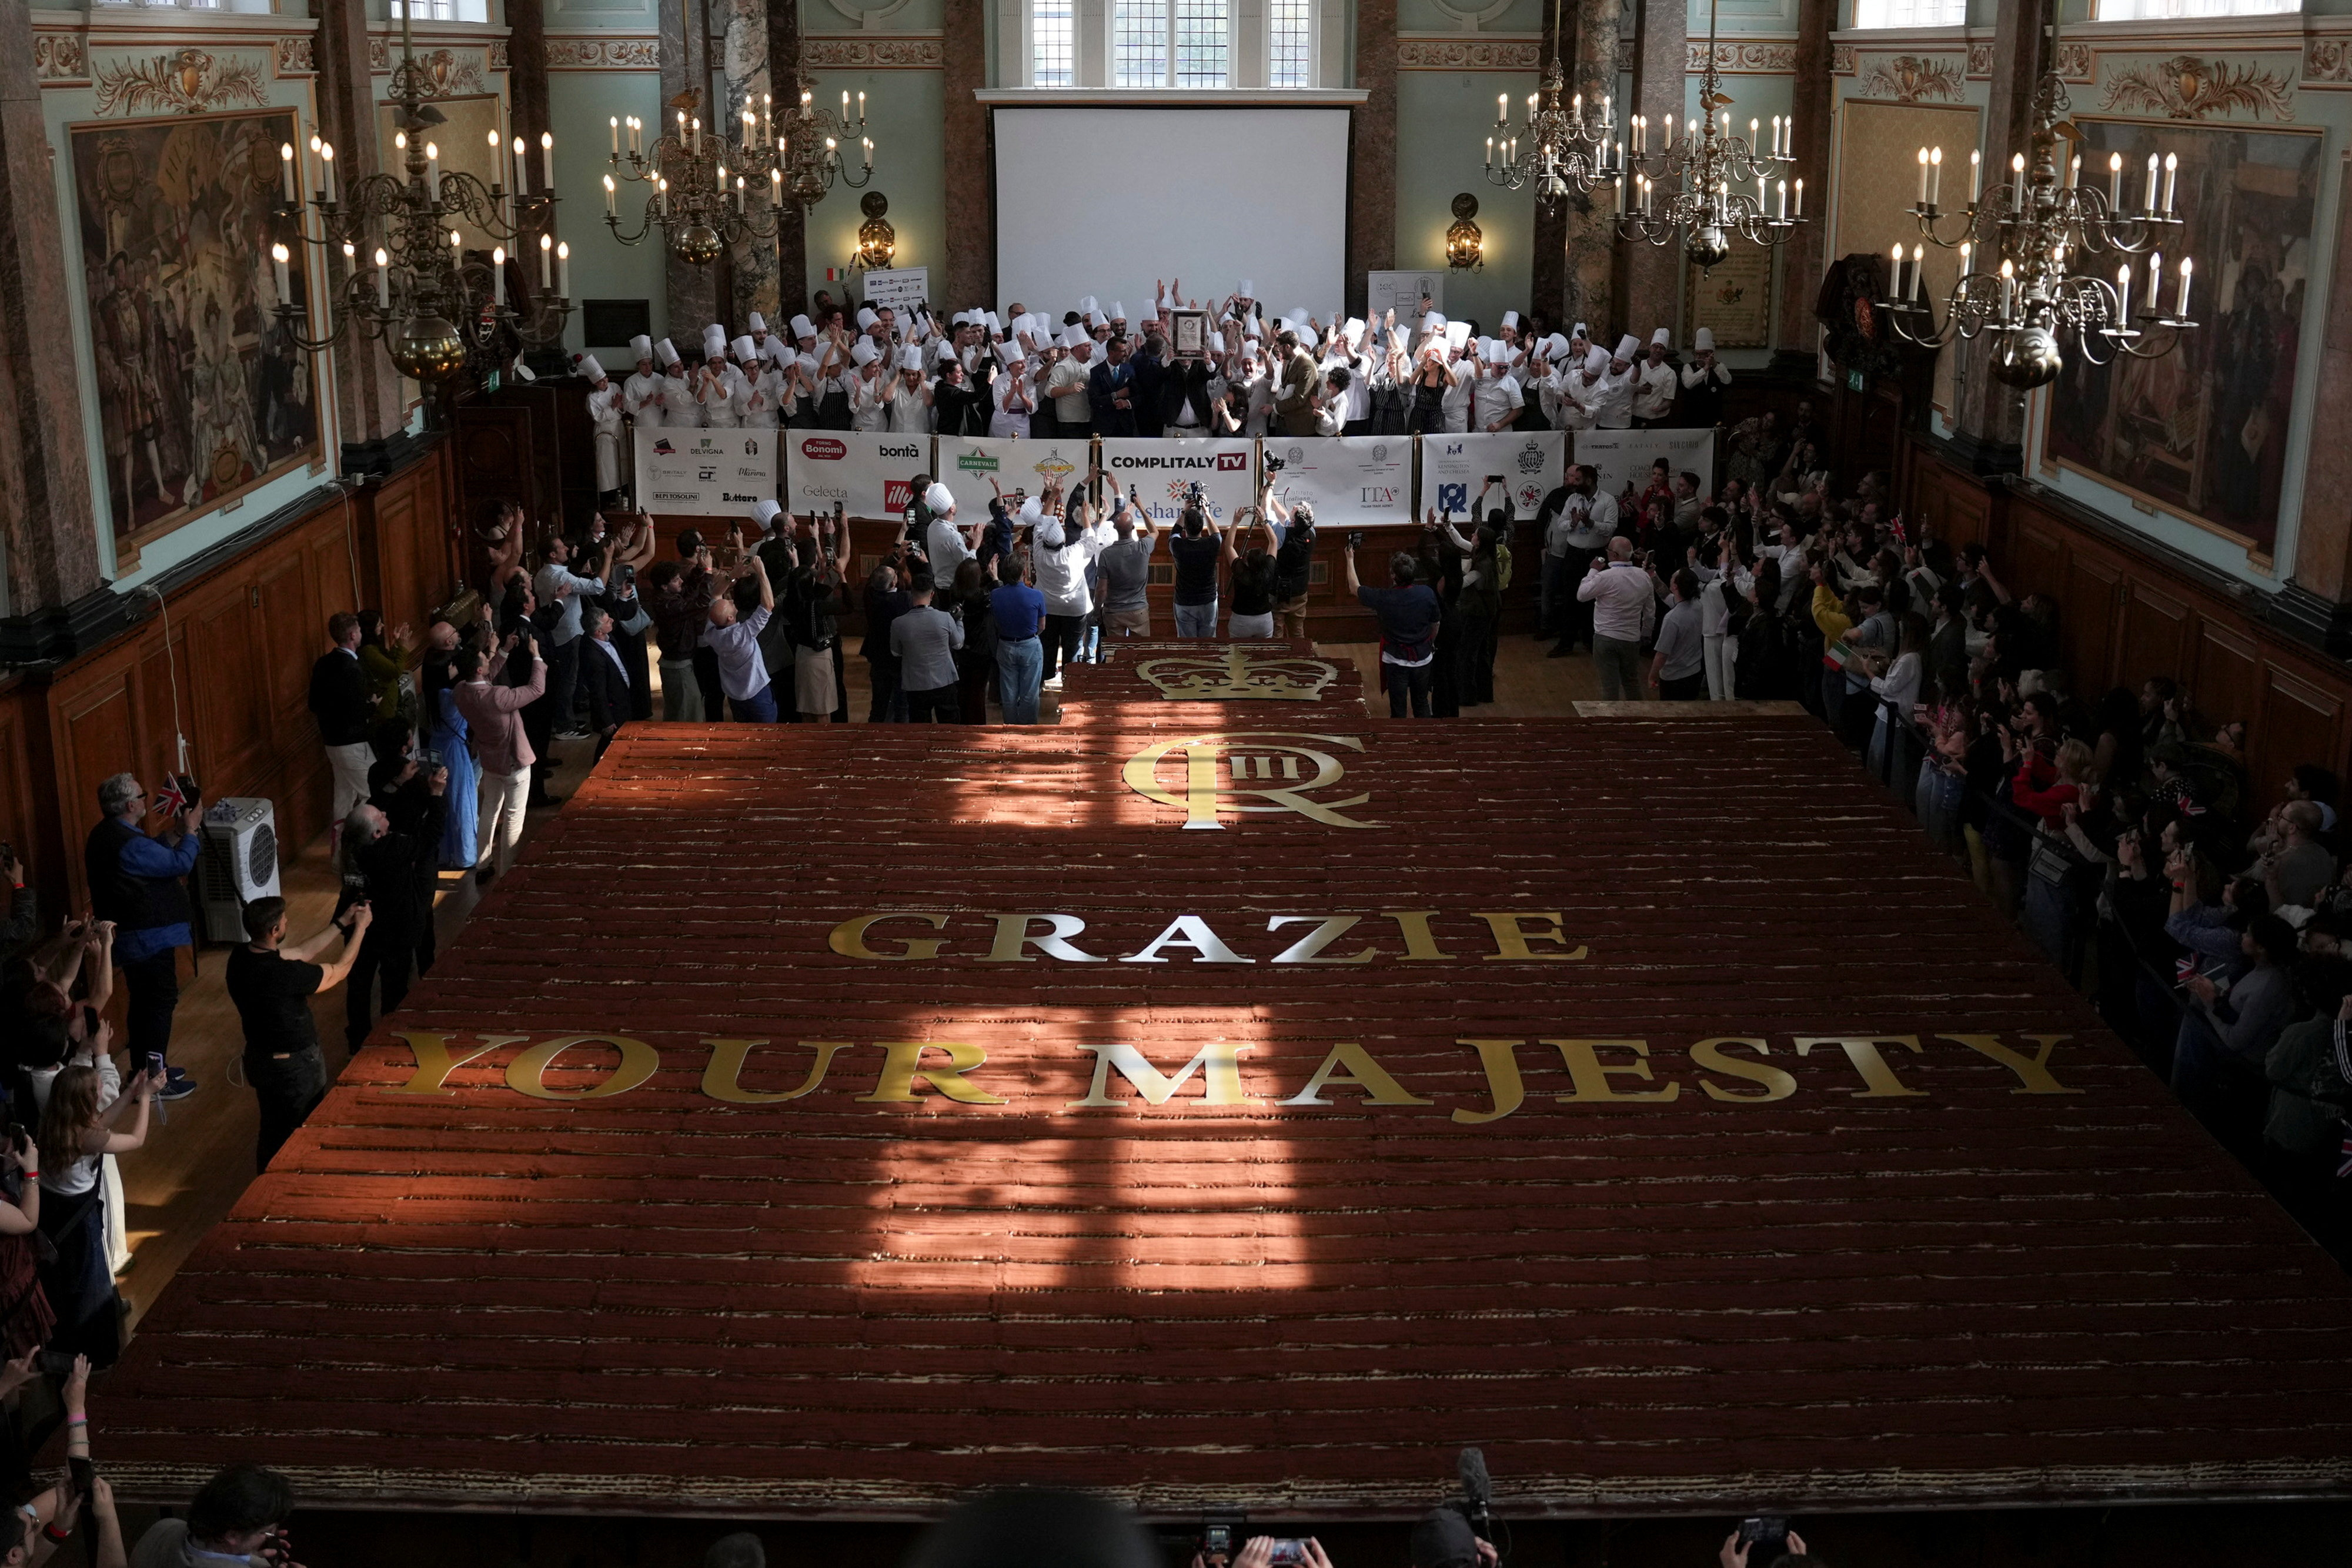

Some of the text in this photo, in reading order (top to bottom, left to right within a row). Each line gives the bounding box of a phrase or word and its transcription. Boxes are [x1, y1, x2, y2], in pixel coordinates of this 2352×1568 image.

[806, 444, 843, 454] Bonomi
[879, 443, 919, 457] bontà
[1111, 456, 1244, 468] COMPLITALY TV
[803, 484, 848, 498] Gelecta
[888, 486, 914, 509] illy
[1361, 487, 1393, 502] ITA
[828, 910, 1588, 965] GRAZIE
[379, 1031, 2086, 1124] YOUR MAJESTY
